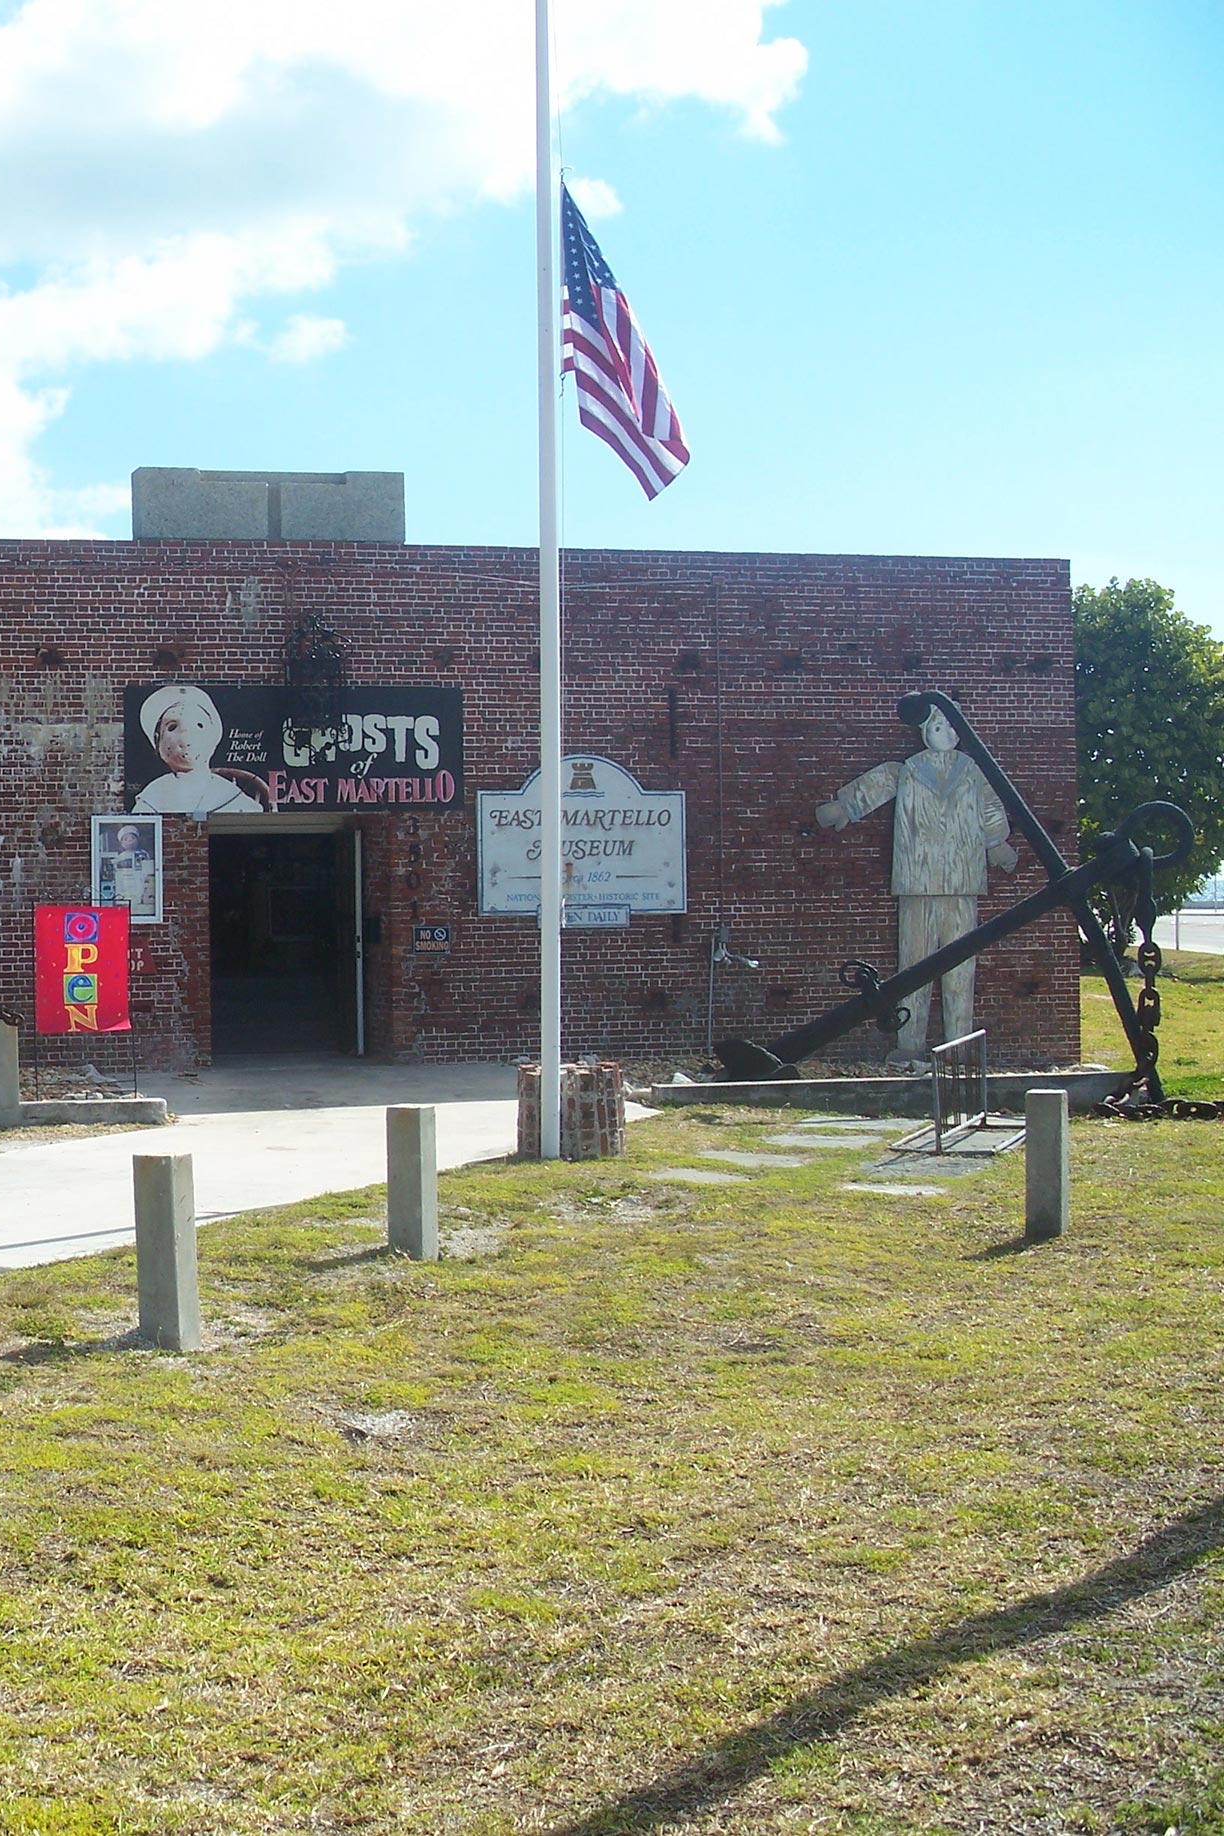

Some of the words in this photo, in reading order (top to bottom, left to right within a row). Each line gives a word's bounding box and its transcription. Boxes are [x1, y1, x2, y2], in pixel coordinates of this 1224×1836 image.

[229, 729, 253, 739] Home
[254, 730, 264, 741] of
[230, 740, 262, 750] Robert
[226, 752, 244, 762] The
[246, 752, 267, 762] Doll
[350, 752, 378, 779] of
[268, 770, 329, 804] EAST
[337, 769, 455, 804] MARTELLO
[560, 809, 672, 832] MARTELLO
[587, 871, 611, 883] 1862
[642, 892, 660, 901] SITE
[588, 911, 621, 923] DAILY
[420, 929, 432, 940] NO
[416, 941, 449, 951] SMOKING
